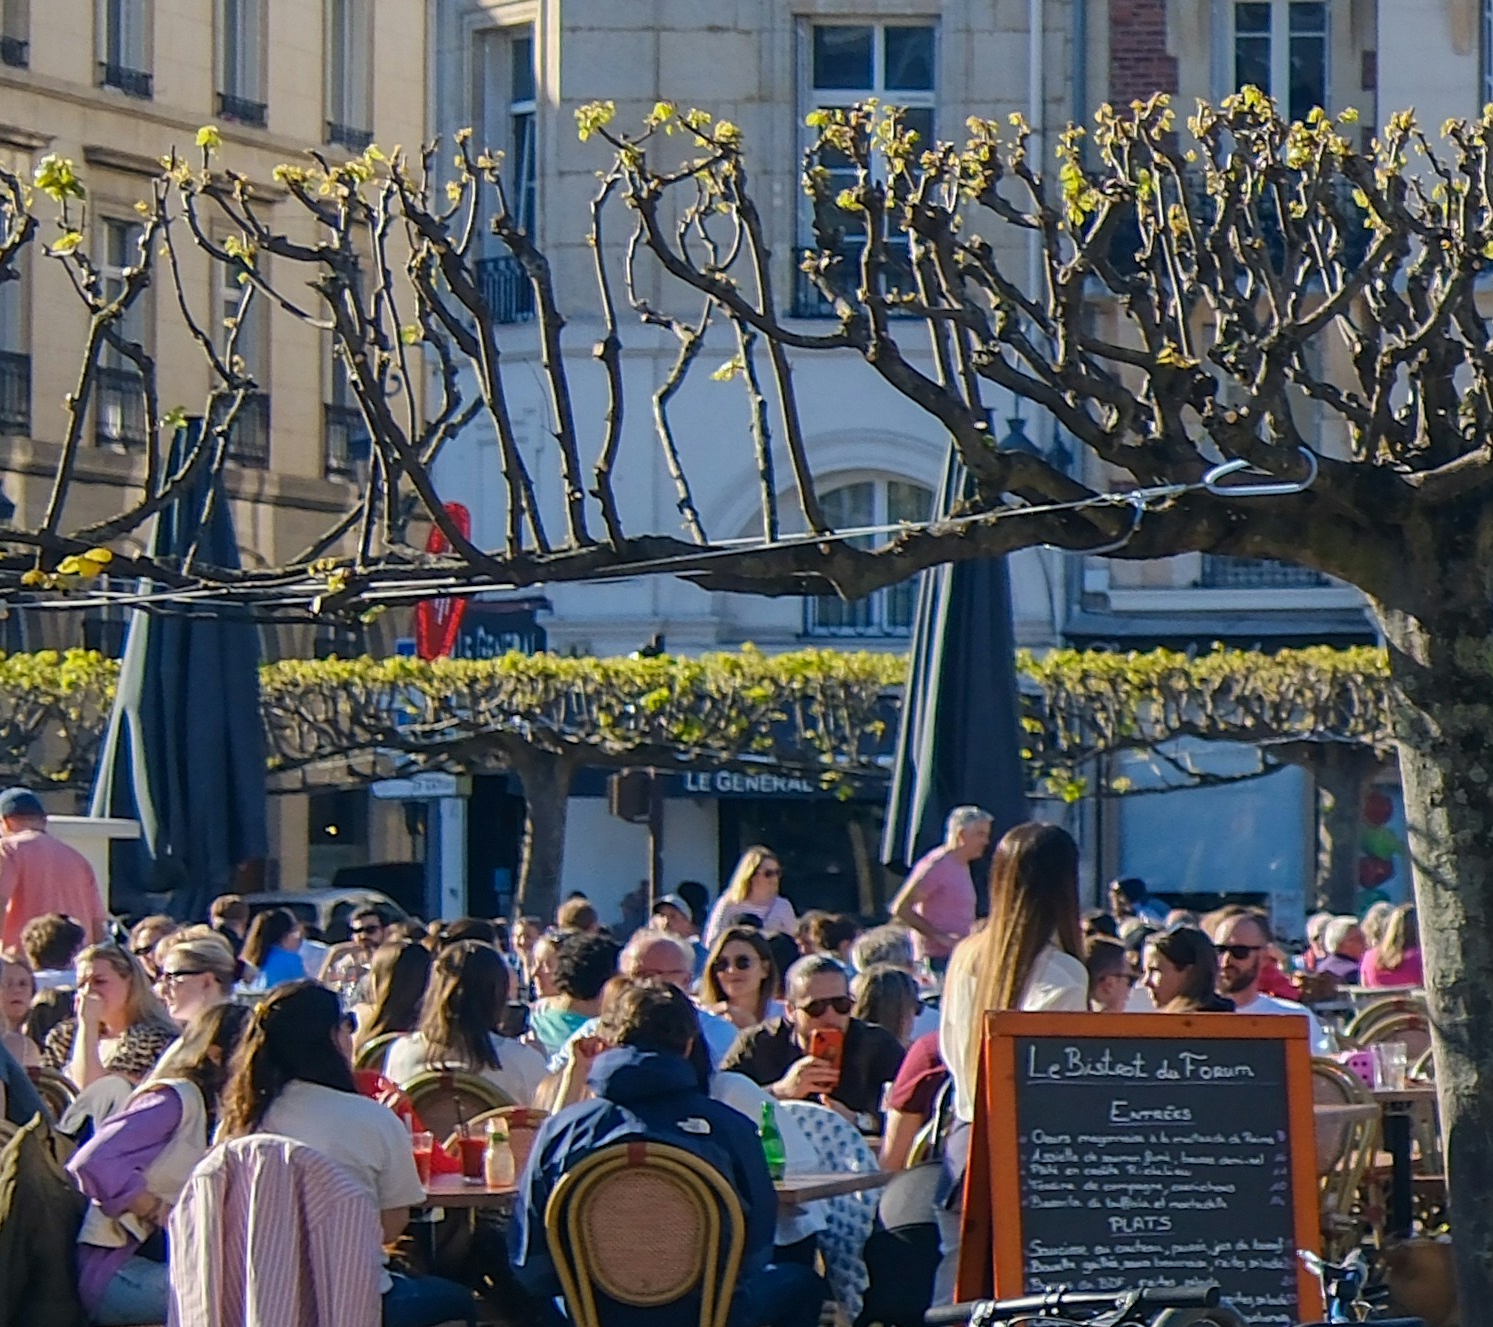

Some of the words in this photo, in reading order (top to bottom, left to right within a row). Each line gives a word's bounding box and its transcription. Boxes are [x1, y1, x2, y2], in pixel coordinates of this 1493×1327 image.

[686, 771, 711, 792] LE
[1064, 1047, 1148, 1077] Bistrot
[1108, 1216, 1172, 1233] PLATS
